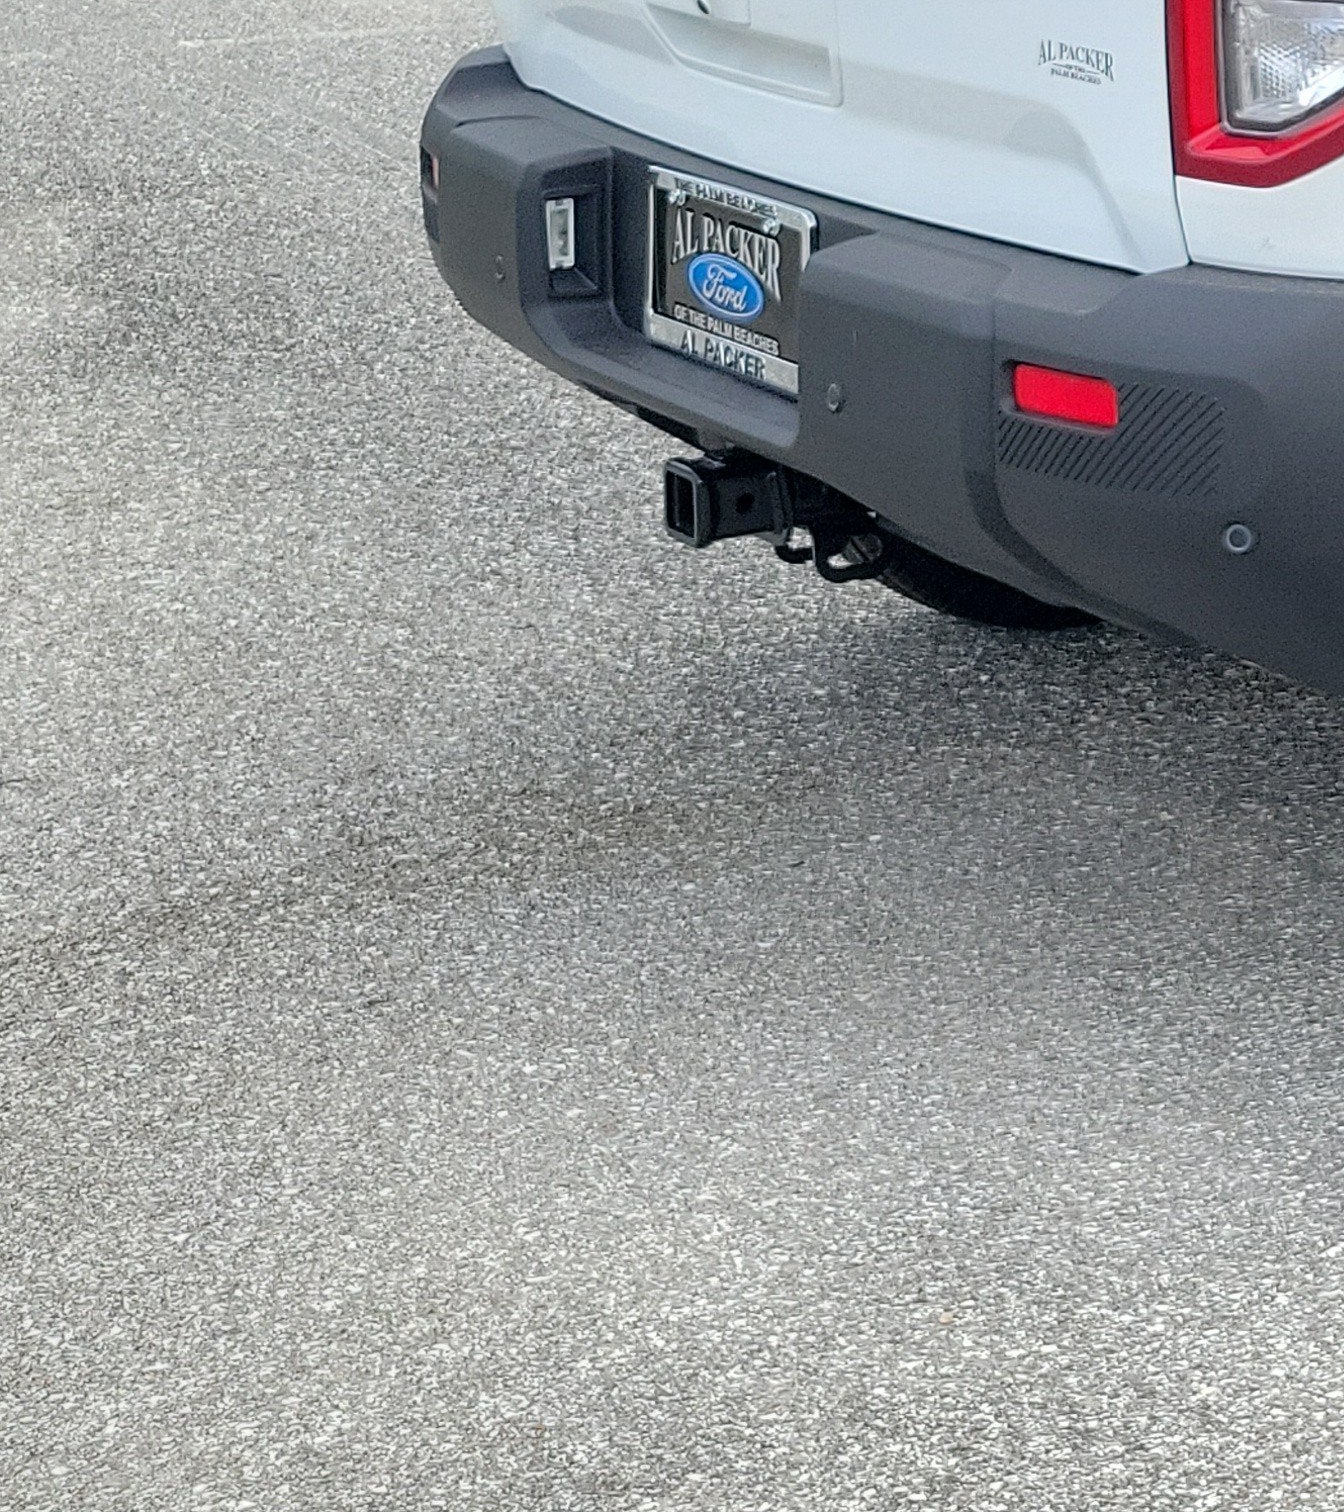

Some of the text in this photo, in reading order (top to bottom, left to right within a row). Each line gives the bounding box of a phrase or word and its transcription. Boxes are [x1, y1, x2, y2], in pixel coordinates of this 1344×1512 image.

[1038, 39, 1114, 82] AL PACKER
[671, 208, 782, 304] AL PACKER
[703, 263, 748, 312] Ford
[673, 303, 780, 356] OF THE PALM BEACHES
[681, 330, 767, 380] AL PACKER
